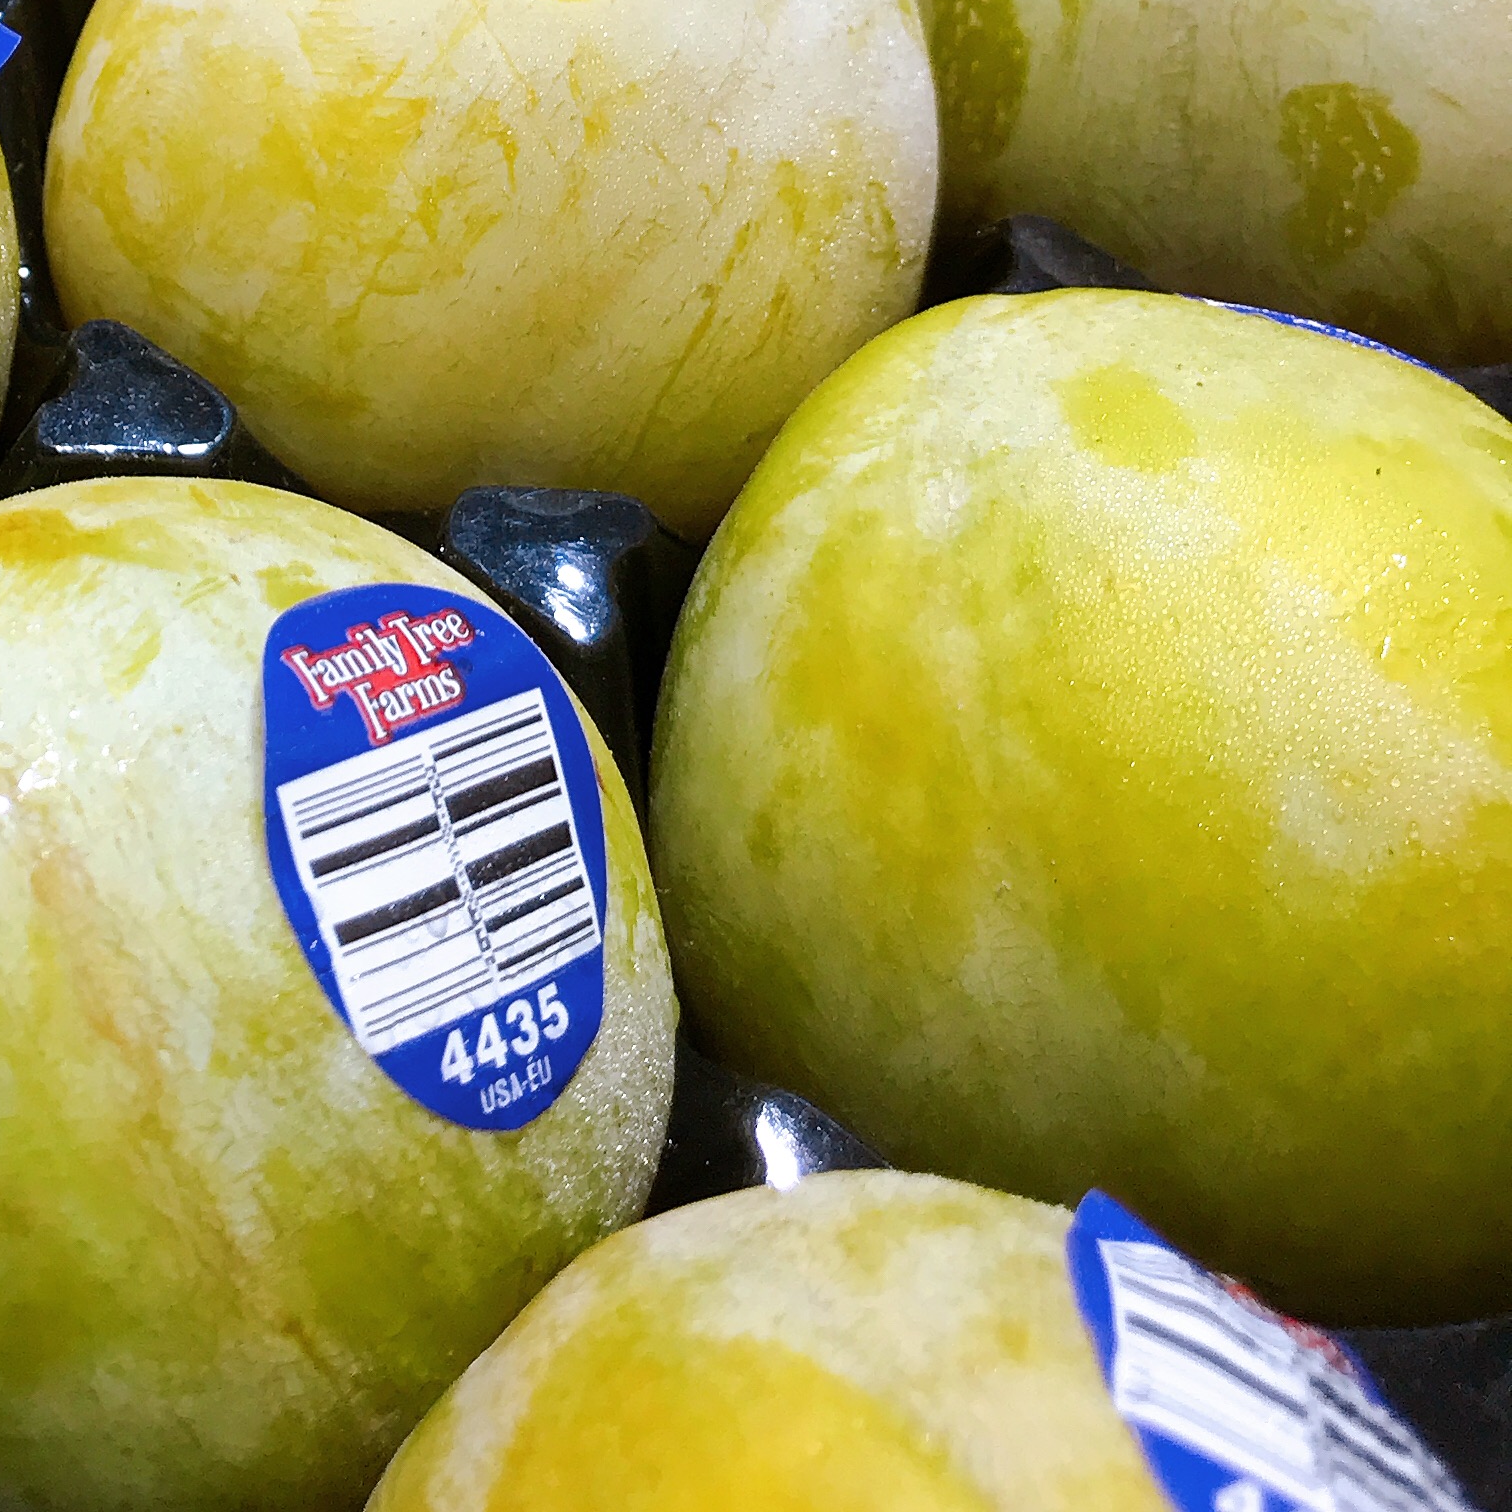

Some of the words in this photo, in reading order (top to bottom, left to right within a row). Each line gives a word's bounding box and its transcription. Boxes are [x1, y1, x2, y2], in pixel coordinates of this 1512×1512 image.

[290, 627, 408, 703] Family
[387, 612, 470, 665] Tree
[353, 666, 462, 741] Farms
[440, 980, 570, 1085] 4435
